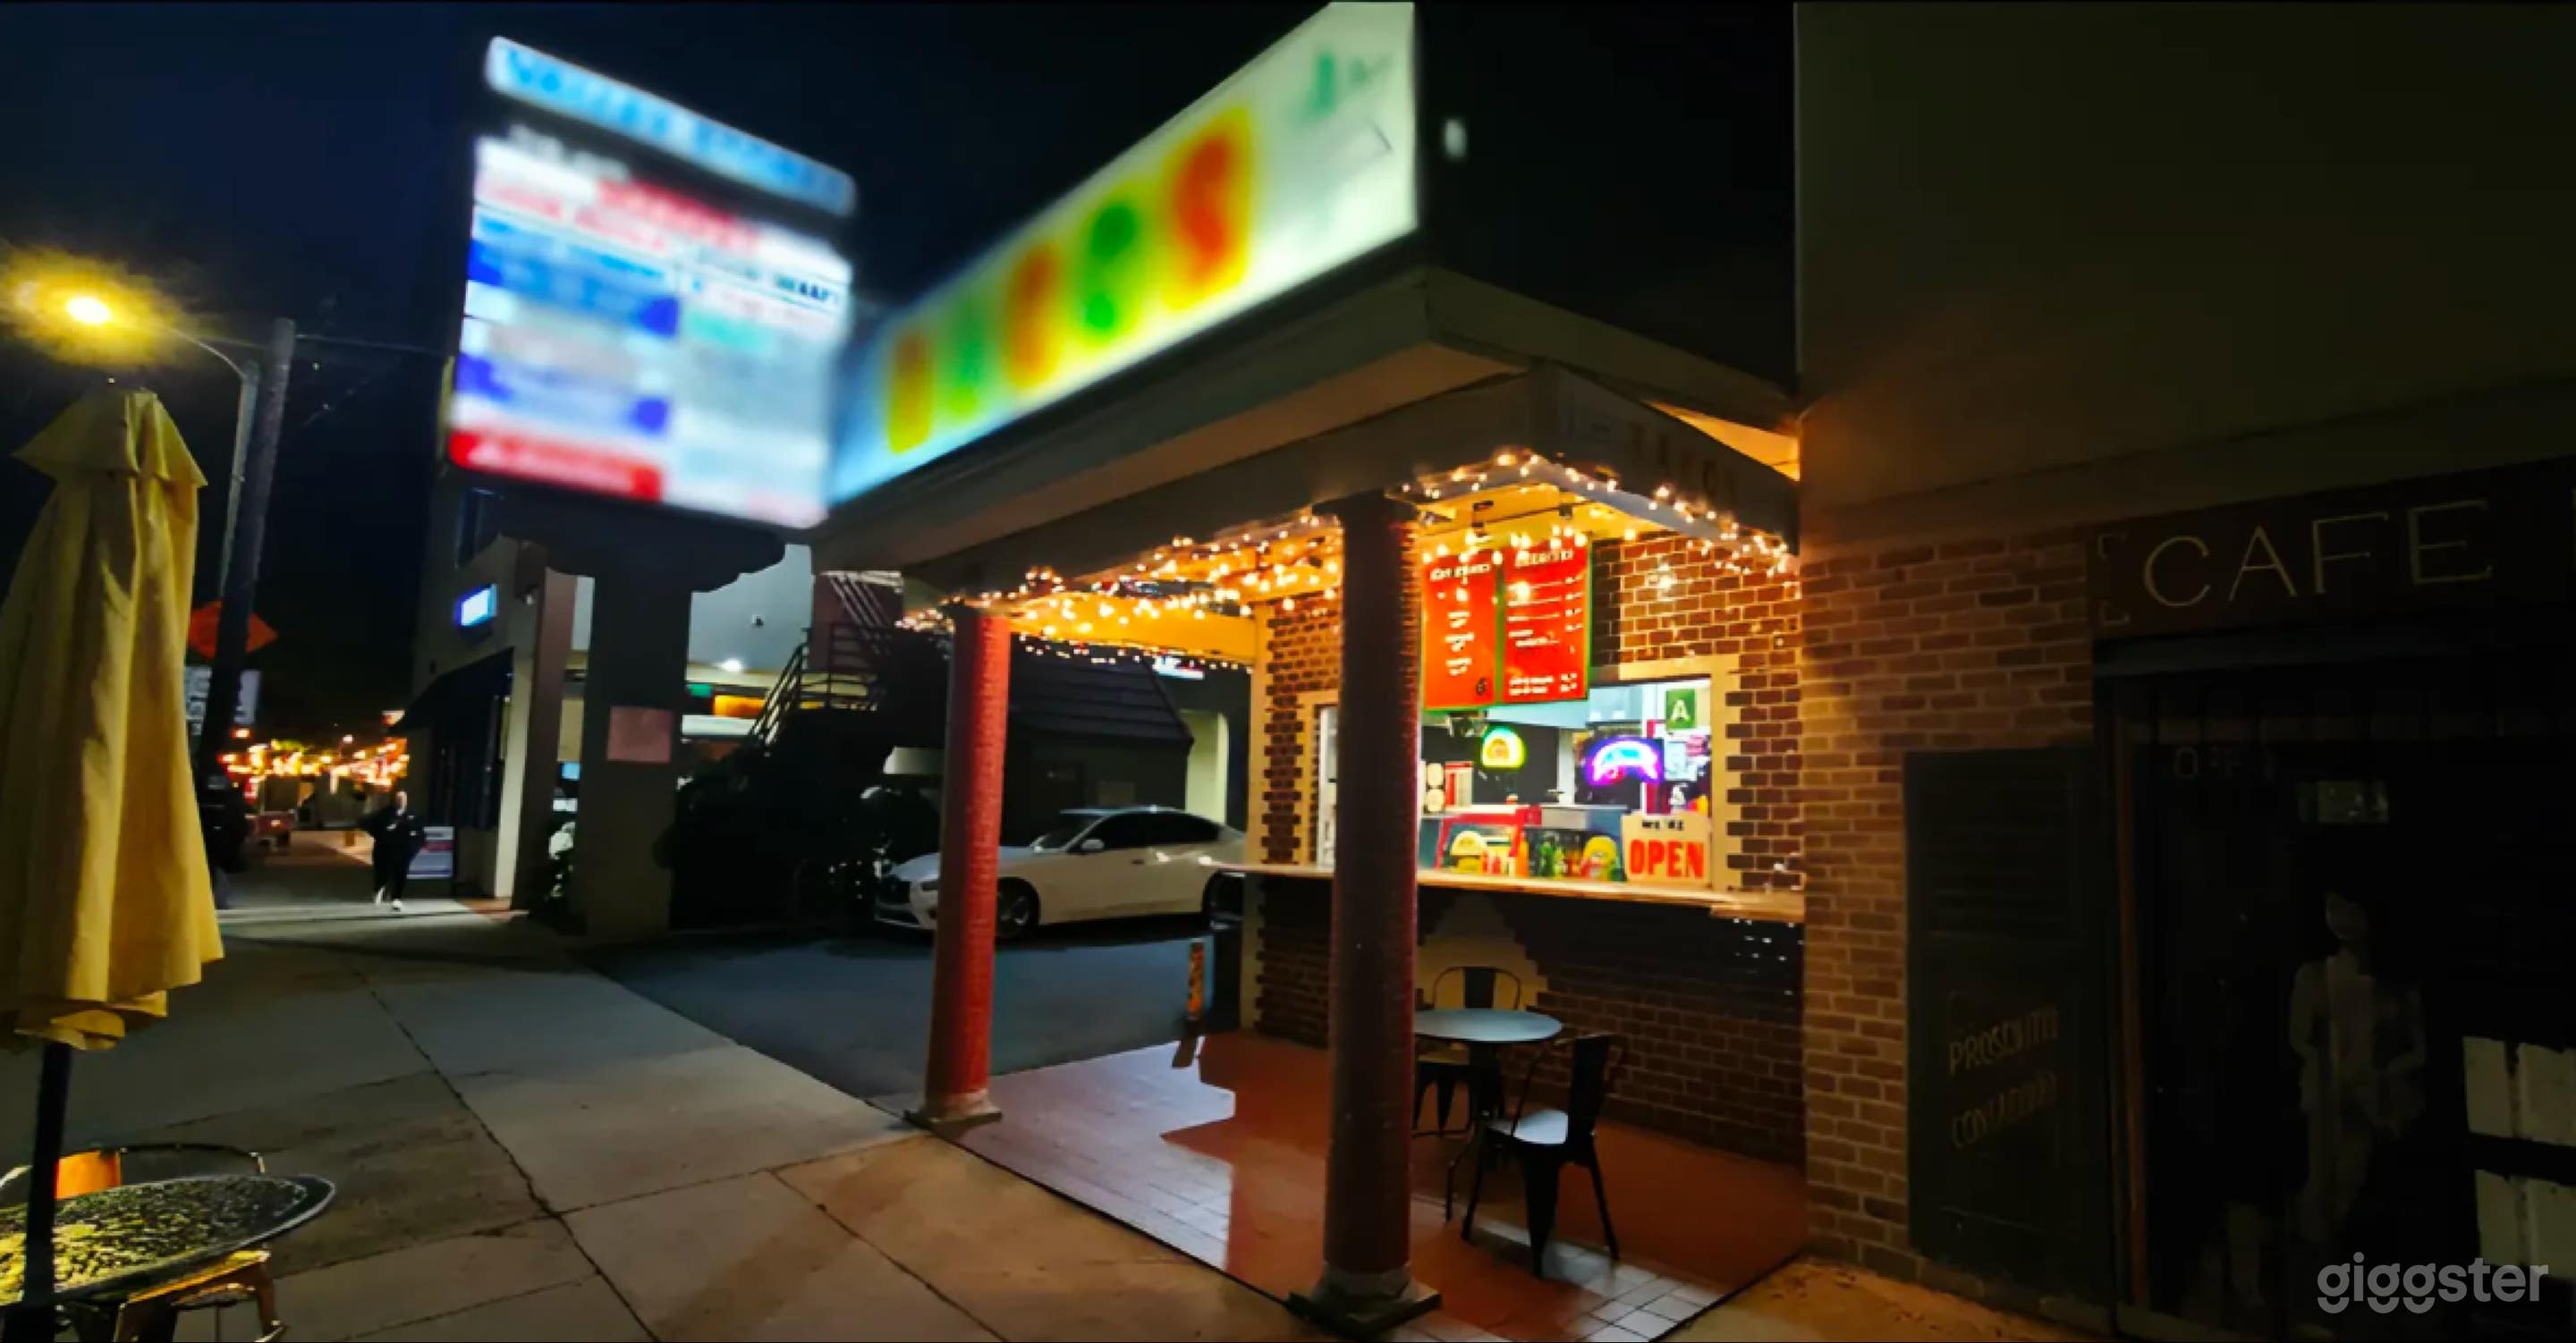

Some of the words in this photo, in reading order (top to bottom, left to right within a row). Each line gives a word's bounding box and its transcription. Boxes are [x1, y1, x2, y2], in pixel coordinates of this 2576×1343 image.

[2143, 497, 2496, 609] CAFE
[1670, 699, 1690, 722] A
[1630, 839, 1705, 879] OPEN
